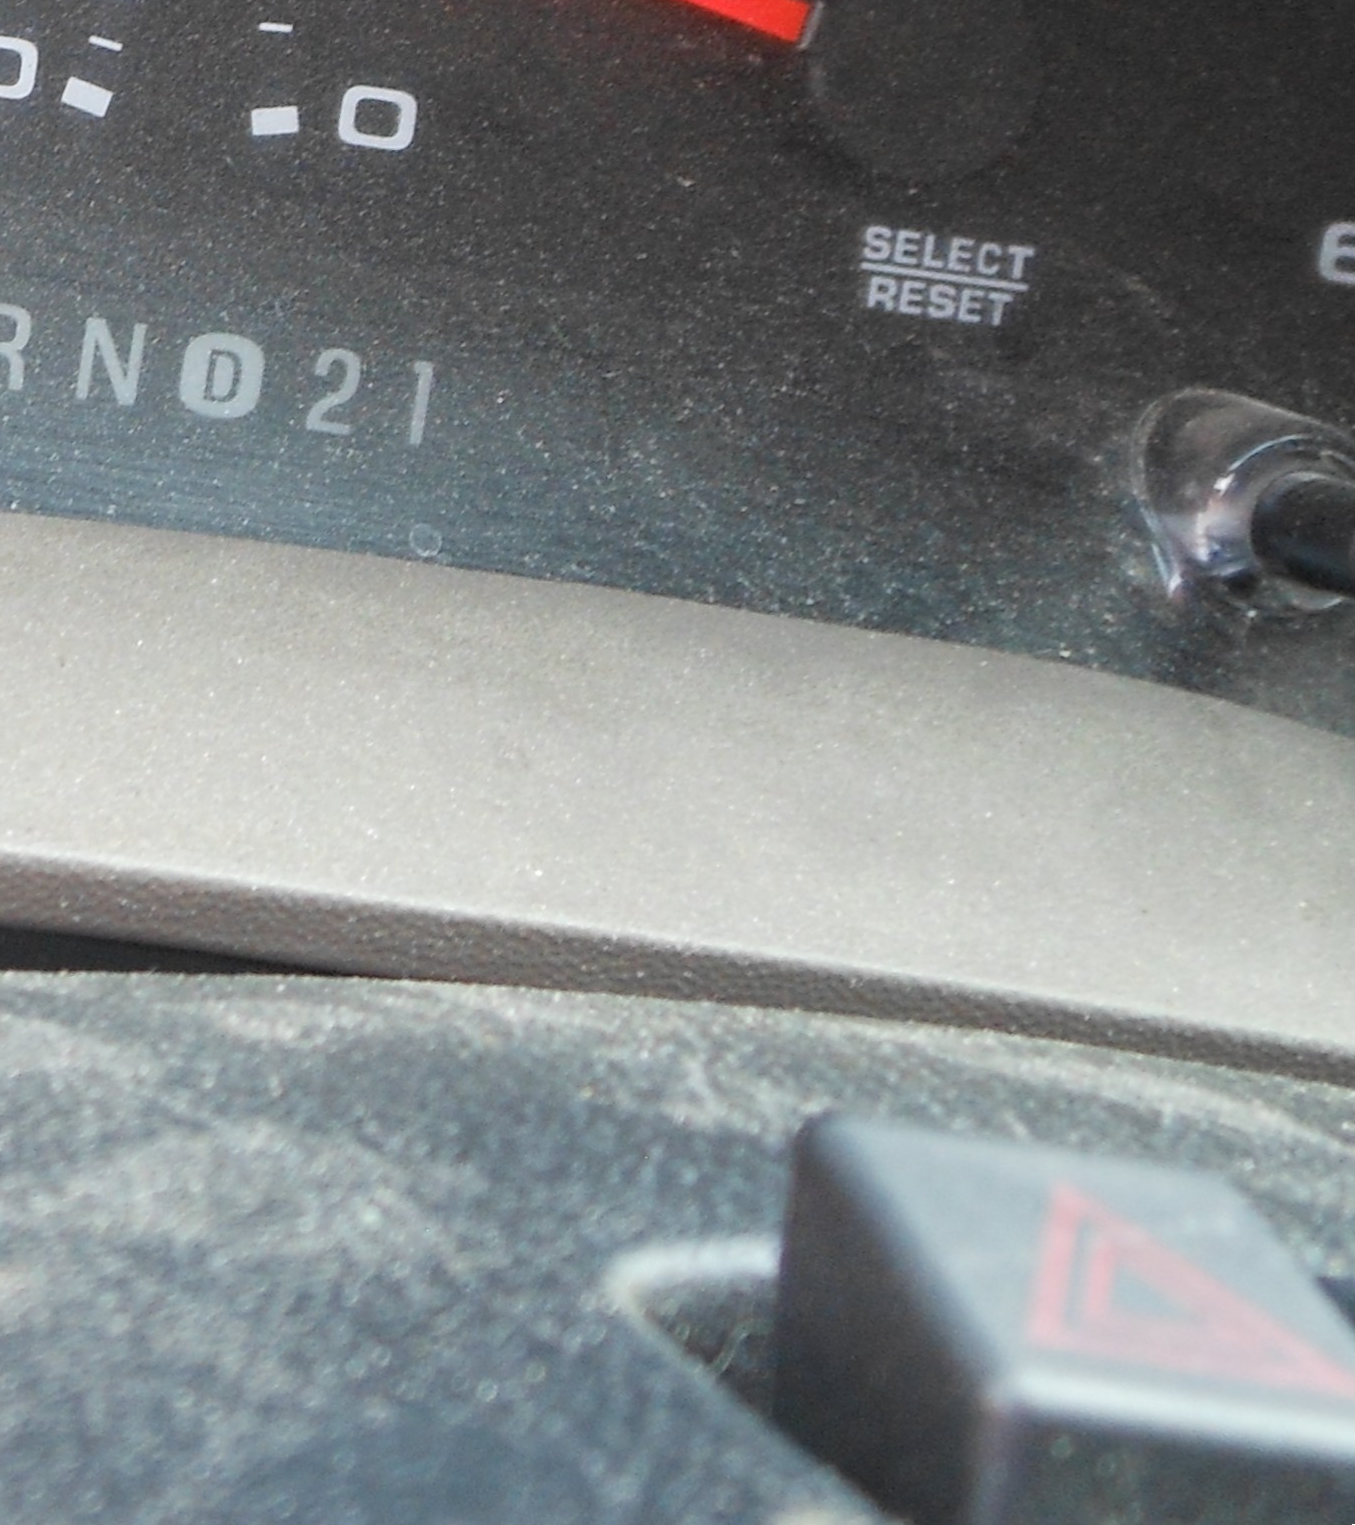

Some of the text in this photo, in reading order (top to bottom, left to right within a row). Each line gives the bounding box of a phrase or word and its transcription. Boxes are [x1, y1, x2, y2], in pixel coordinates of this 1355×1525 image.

[337, 85, 417, 151] 0
[861, 225, 1035, 278] SELECT
[867, 277, 1013, 326] RESET
[75, 315, 148, 406] N
[304, 348, 362, 435] 2
[408, 360, 434, 446] 1
